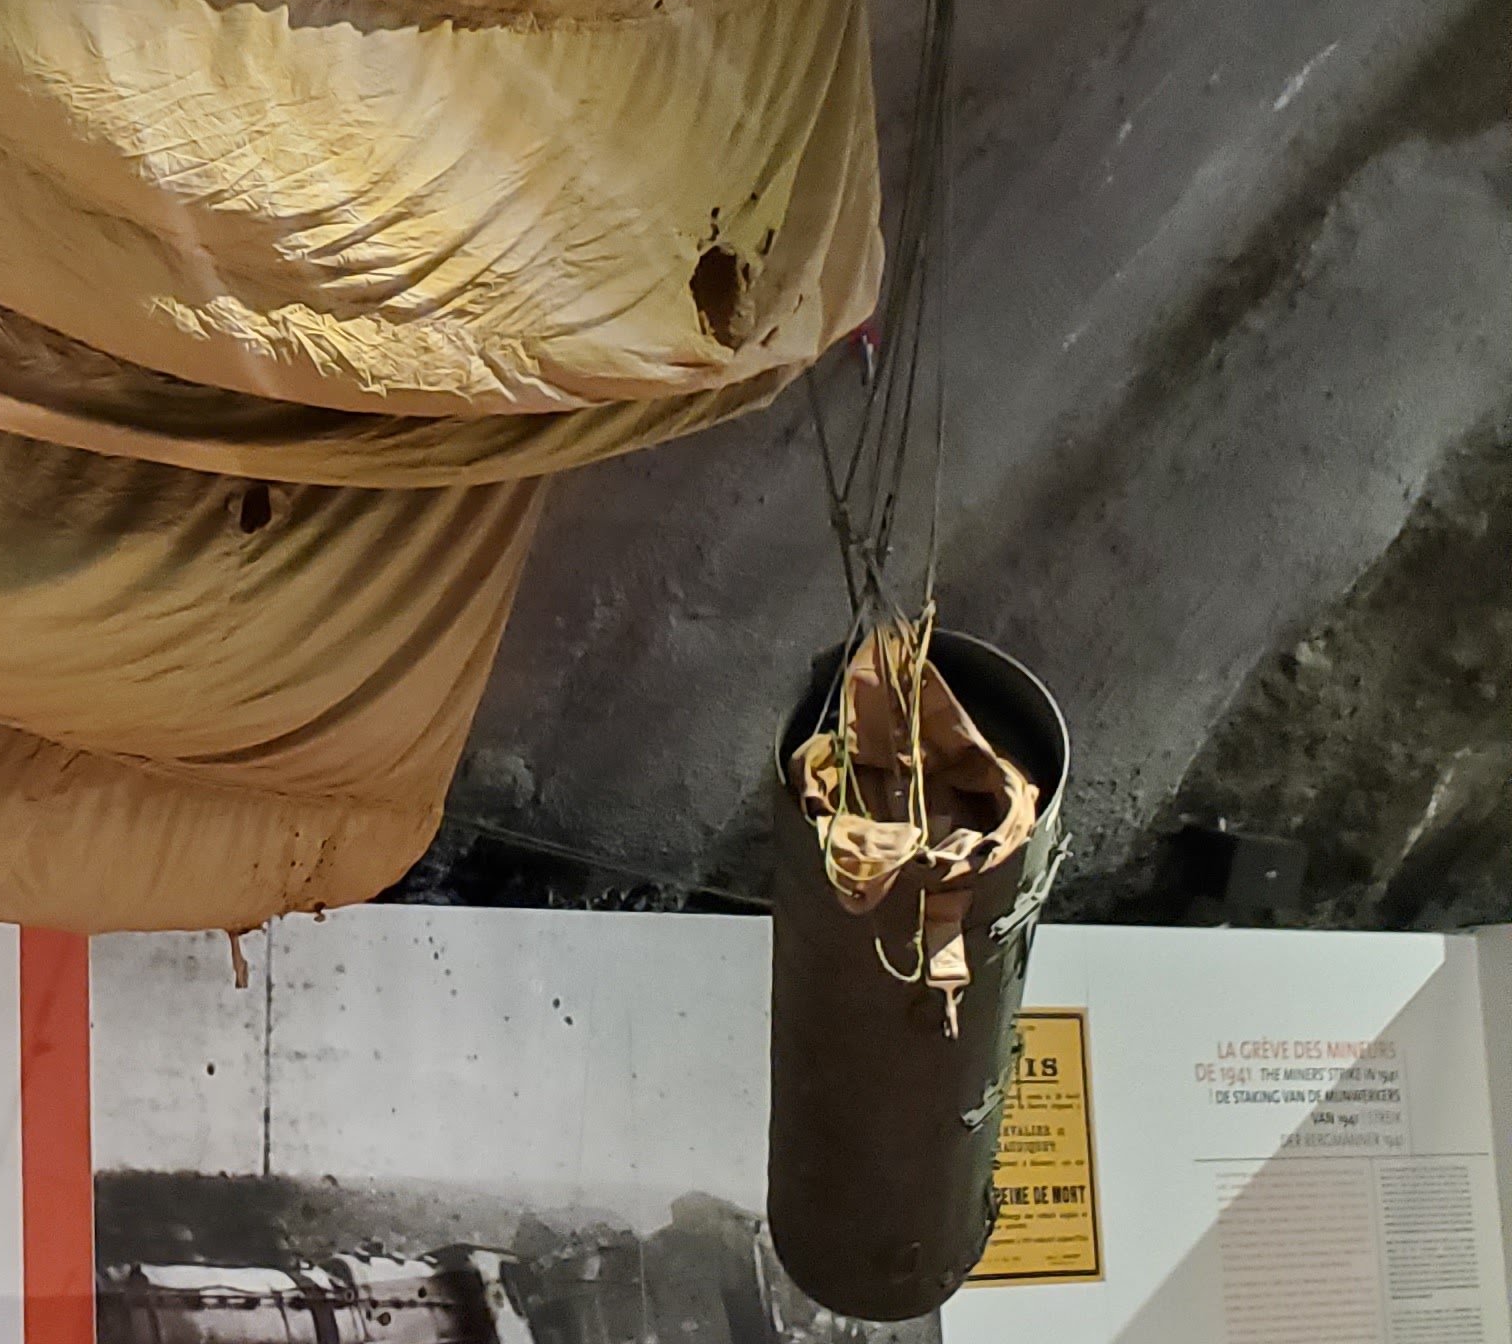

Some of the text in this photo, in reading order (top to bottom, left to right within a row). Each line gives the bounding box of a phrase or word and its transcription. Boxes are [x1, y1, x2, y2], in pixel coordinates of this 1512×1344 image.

[1217, 1041, 1236, 1059] LA
[1240, 1037, 1289, 1059] GRÈVE
[1294, 1040, 1322, 1058] DES
[1194, 1063, 1216, 1082] DE
[1220, 1066, 1252, 1086] 1941
[1260, 1067, 1281, 1081] THE
[1215, 1089, 1231, 1104] DE
[1234, 1089, 1281, 1104] STAKING
[1281, 1089, 1306, 1104] VAN
[1308, 1089, 1322, 1103] DE
[1033, 1185, 1049, 1204] DE
[1052, 1185, 1086, 1204] MORT
